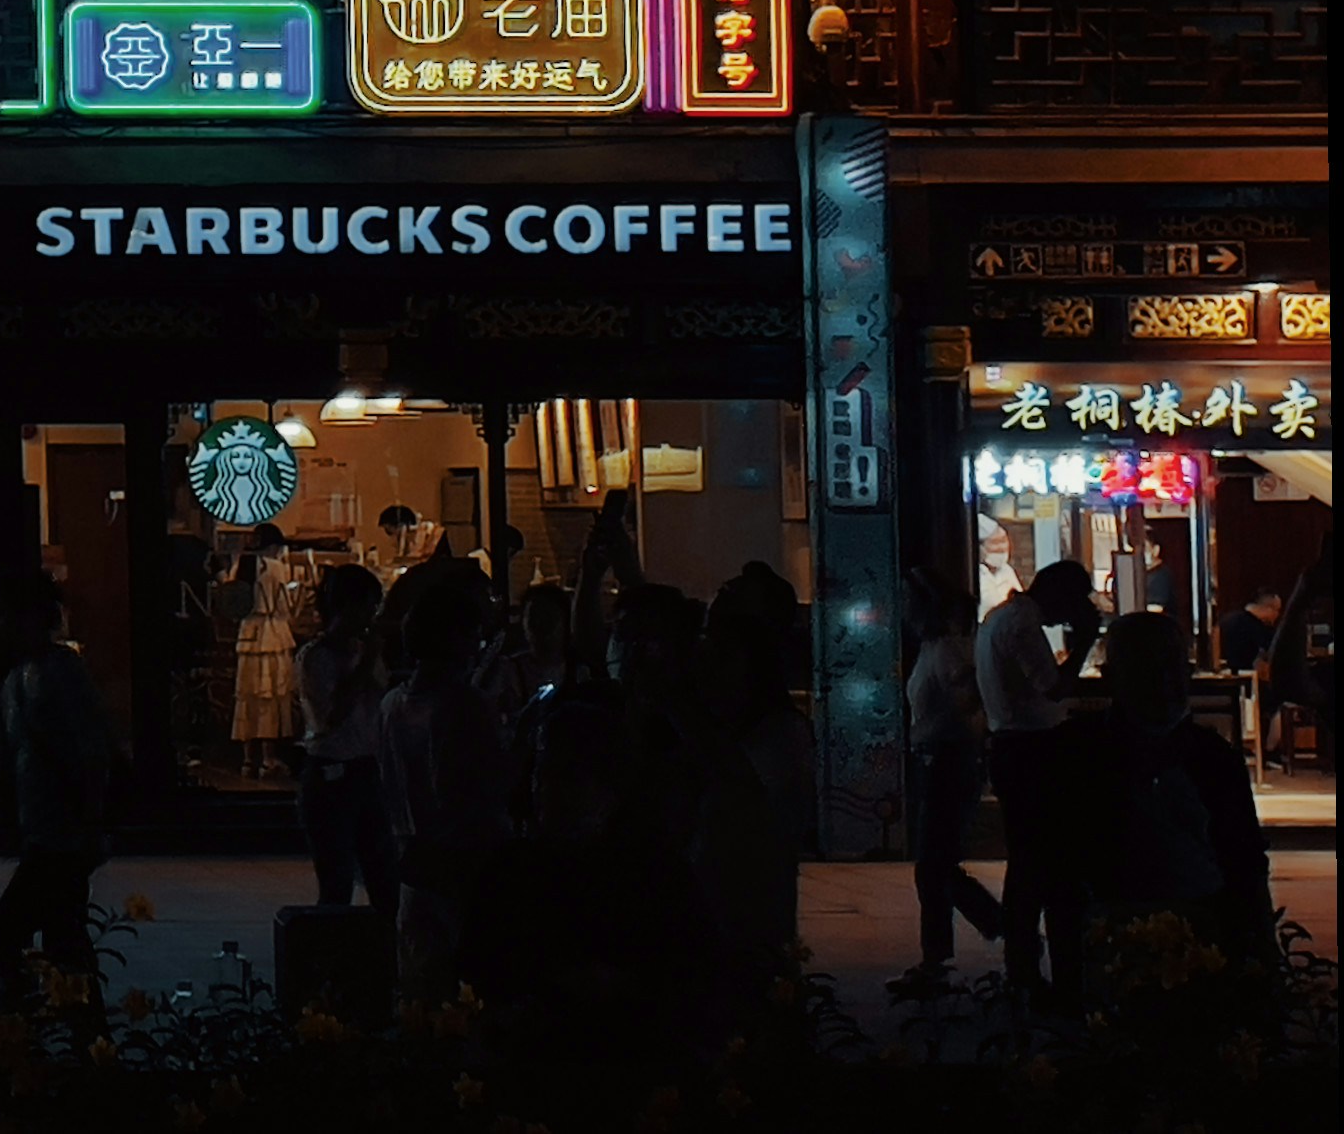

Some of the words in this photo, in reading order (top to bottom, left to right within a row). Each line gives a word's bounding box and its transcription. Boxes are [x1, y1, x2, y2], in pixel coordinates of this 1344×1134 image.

[383, 59, 608, 92] 给您带来好运气
[34, 204, 492, 257] STARBUCKS
[503, 203, 793, 256] COFFEE
